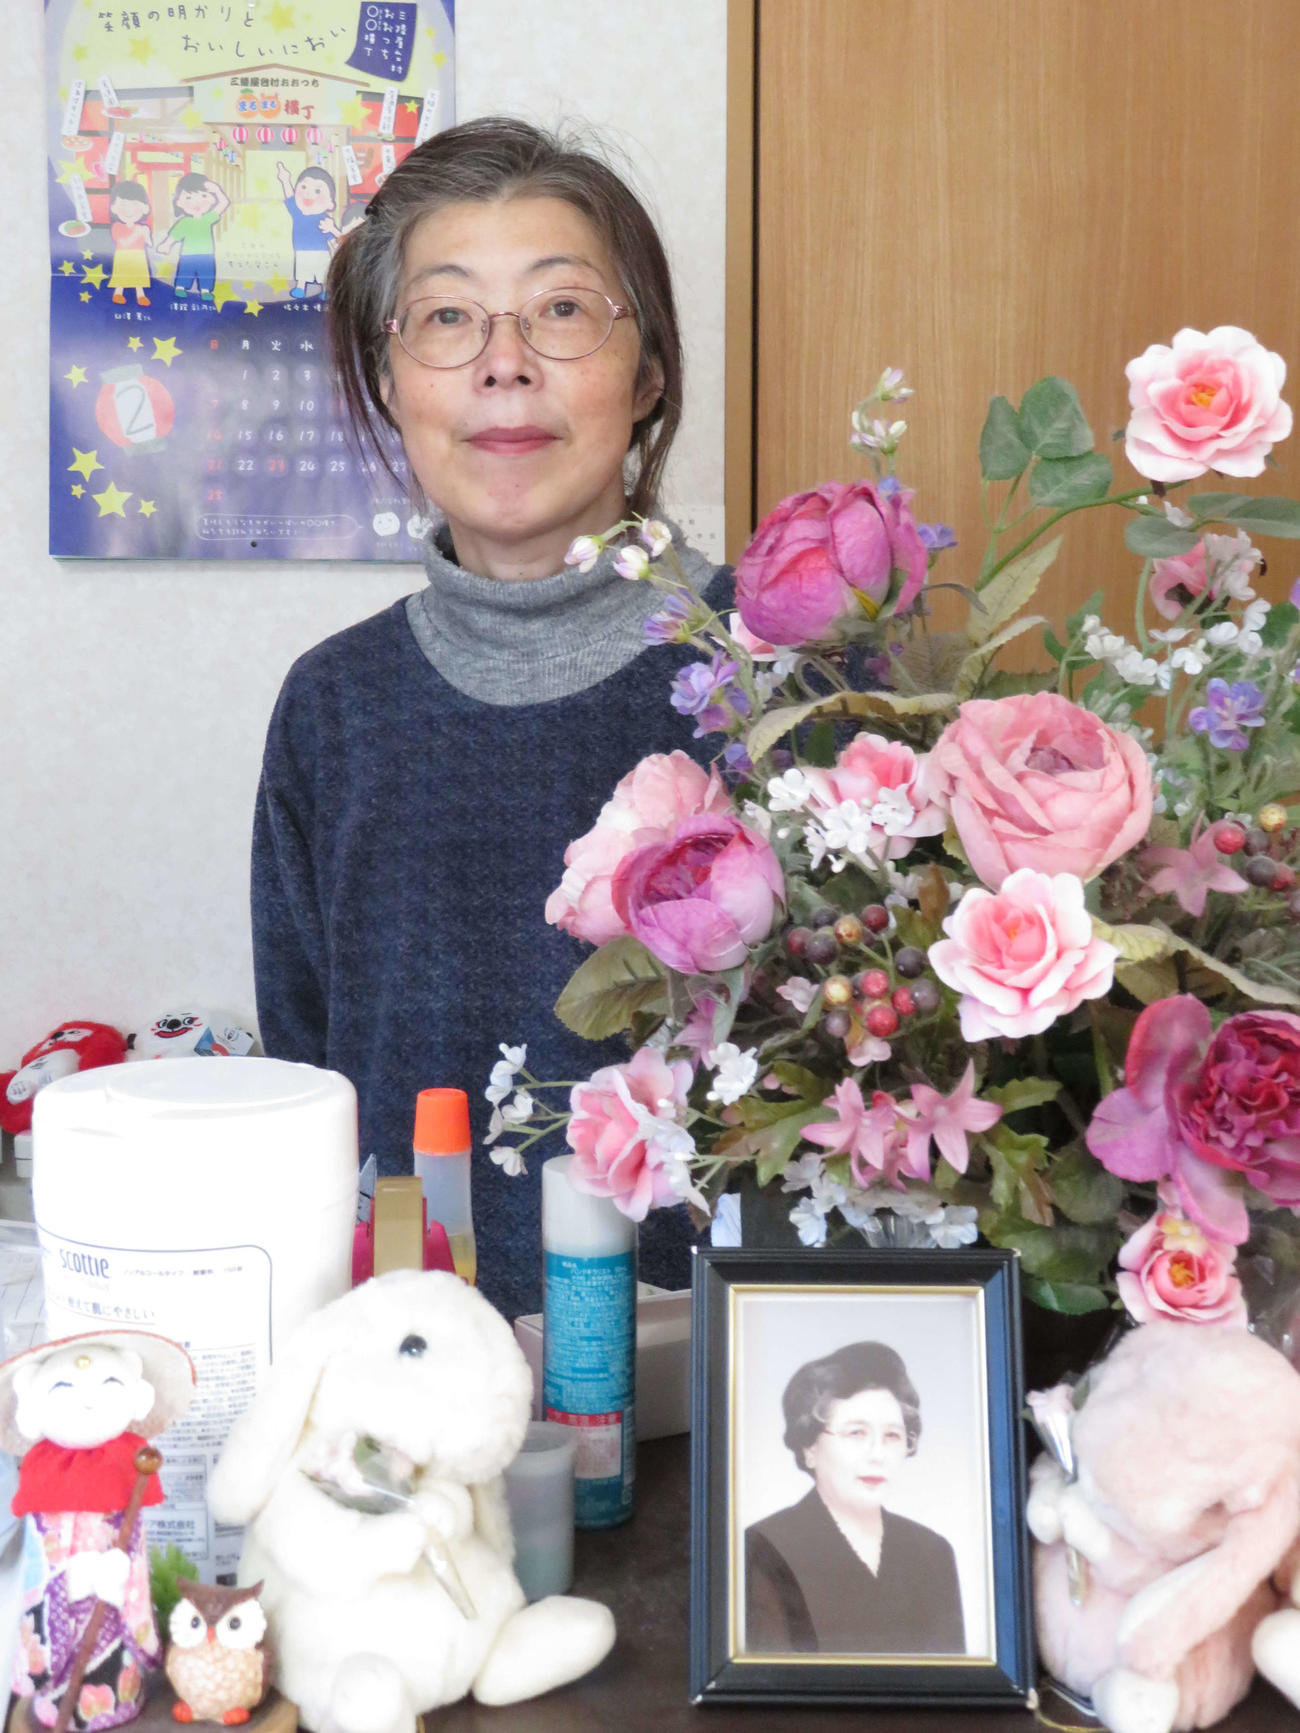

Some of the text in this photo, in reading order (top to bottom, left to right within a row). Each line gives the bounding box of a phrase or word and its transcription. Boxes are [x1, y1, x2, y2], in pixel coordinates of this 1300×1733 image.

[98, 4, 256, 33] 笑顔の明かりと
[181, 25, 347, 59] おいしいにおい
[241, 339, 250, 351] 月
[271, 339, 281, 351] 火
[300, 340, 314, 352] 水
[271, 369, 281, 381] 2
[303, 369, 313, 382] 3
[114, 383, 156, 436] 2
[241, 400, 249, 411] 8
[272, 400, 281, 411] 9
[299, 400, 314, 412] 10
[238, 430, 253, 442] 15
[269, 430, 285, 442] 16
[299, 430, 315, 442] 17
[330, 430, 344, 443] 18
[237, 459, 255, 472] 22
[299, 460, 316, 472] 24
[330, 460, 346, 473] 25
[391, 461, 407, 473] 27
